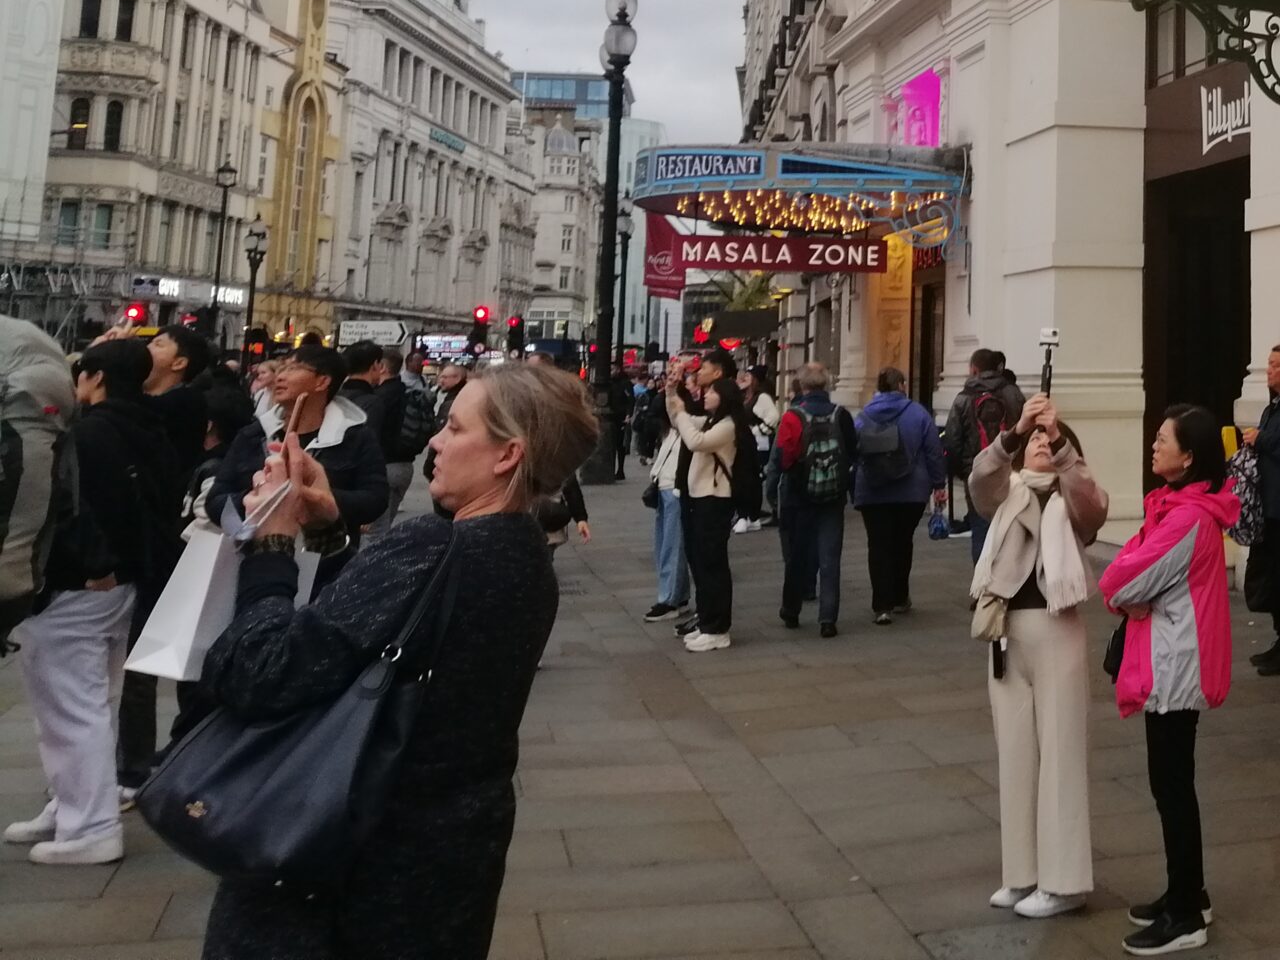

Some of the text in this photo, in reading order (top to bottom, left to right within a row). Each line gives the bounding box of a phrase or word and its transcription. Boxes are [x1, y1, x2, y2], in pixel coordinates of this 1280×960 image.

[1201, 80, 1251, 156] Lillywh
[656, 154, 758, 180] RESTAURANT
[682, 240, 880, 266] MASALA ZONE
[158, 277, 180, 297] GUYS
[225, 287, 243, 305] GUYS
